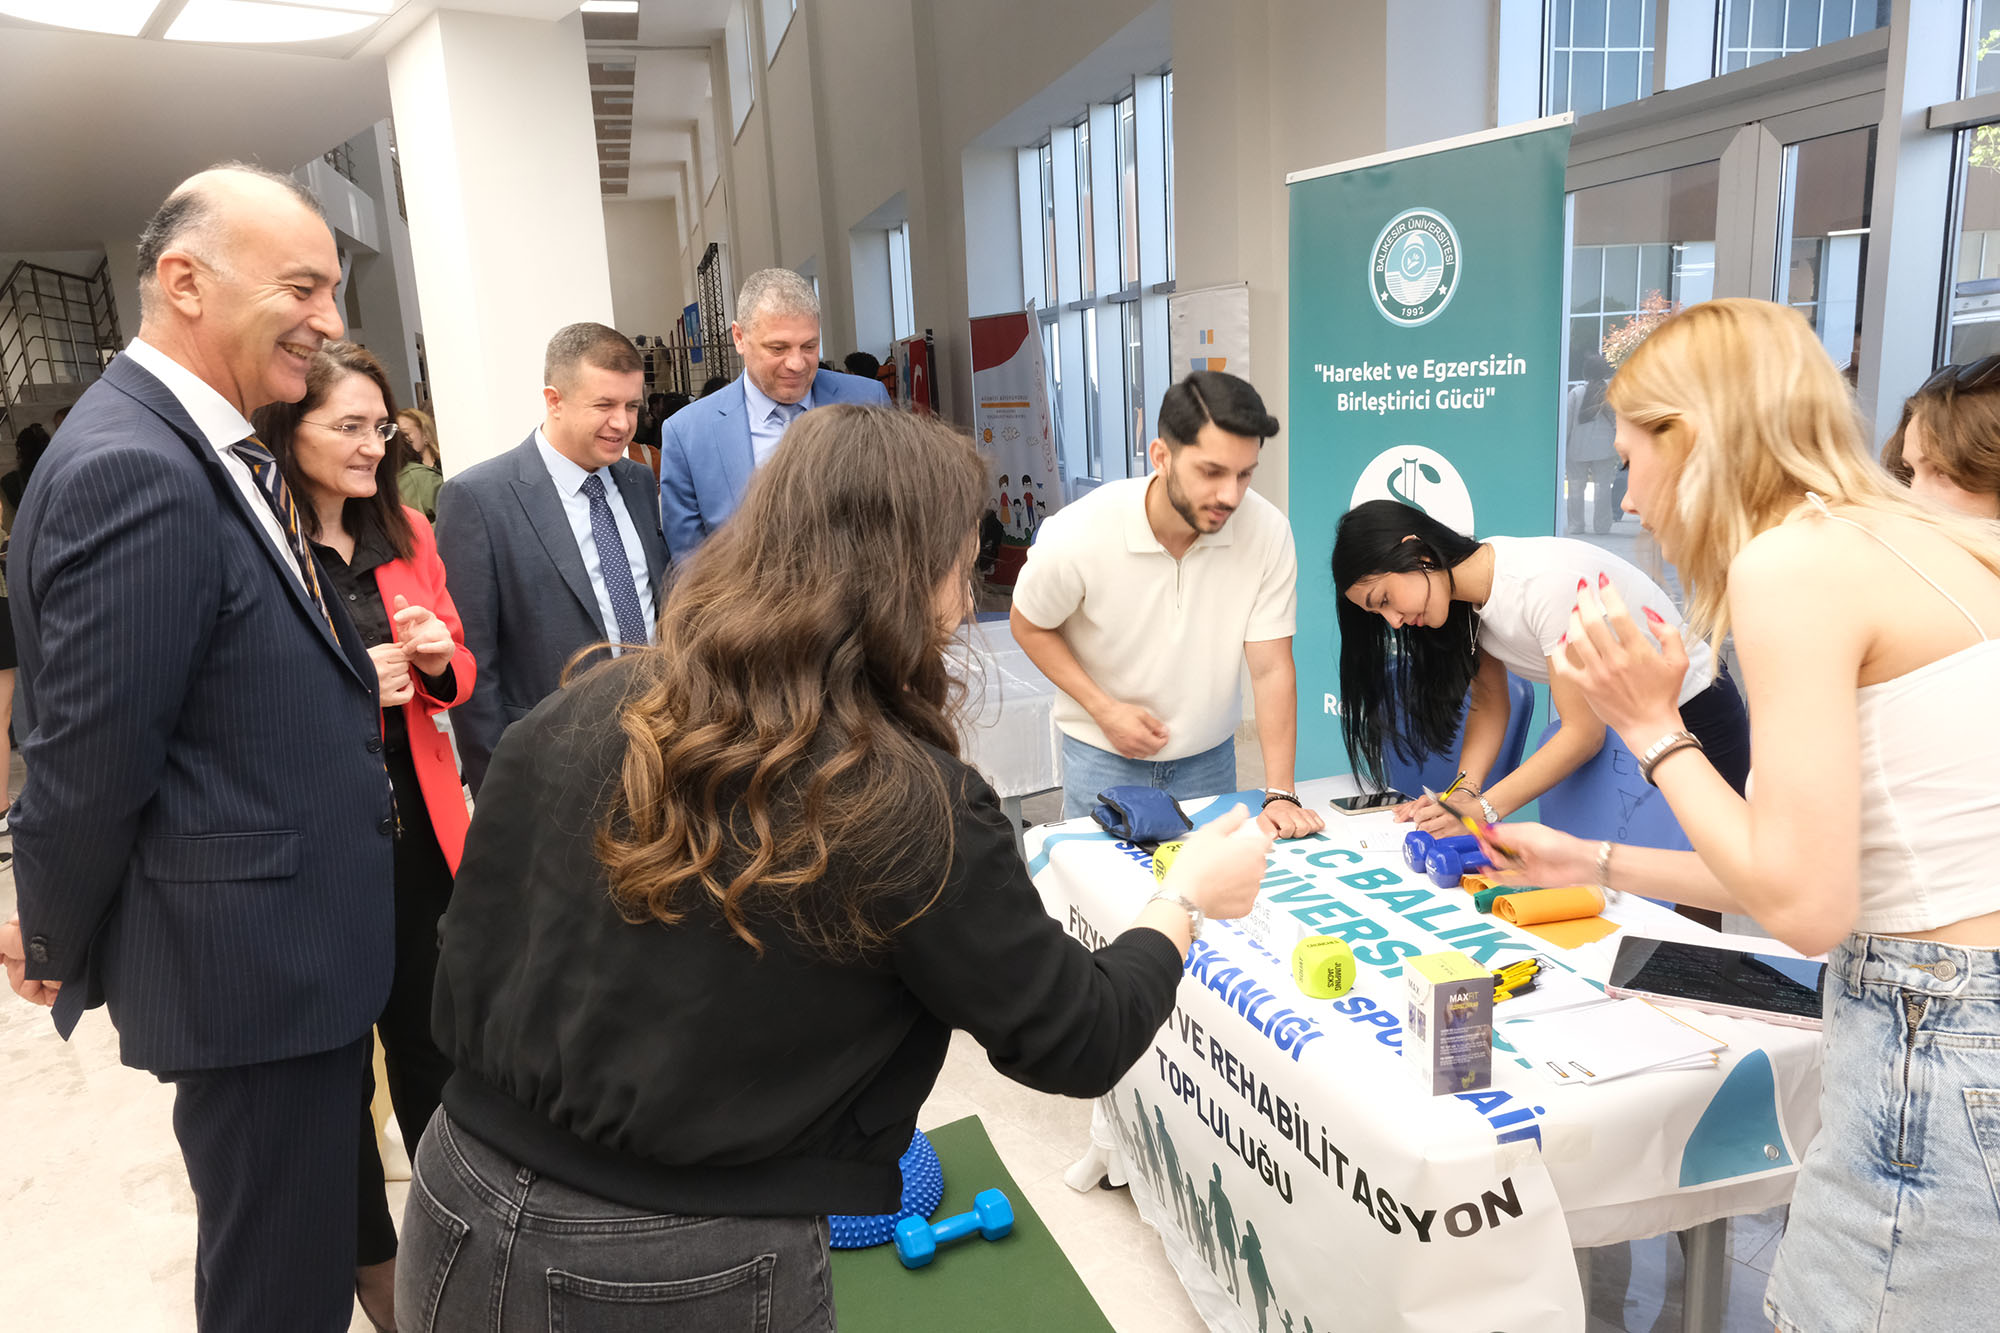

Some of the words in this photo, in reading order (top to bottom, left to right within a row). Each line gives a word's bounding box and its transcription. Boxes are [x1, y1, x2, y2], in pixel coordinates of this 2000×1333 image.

[1376, 223, 1406, 272] BALIKESİR
[1408, 218, 1455, 266] ÜNİVERSİTESİ
[1401, 306, 1425, 317] 1992
[1314, 361, 1392, 383] "Hareket
[1396, 364, 1418, 380] ve
[1423, 353, 1527, 382] Egzersizin
[1337, 389, 1431, 415] Birleştirici
[1436, 387, 1496, 410] Gücü"
[1336, 868, 1572, 972] BALIK
[1155, 1045, 1293, 1205] TOPLULUĞU
[1176, 1005, 1206, 1061] VE
[1209, 1035, 1523, 1243] REHABİLİTASYON
